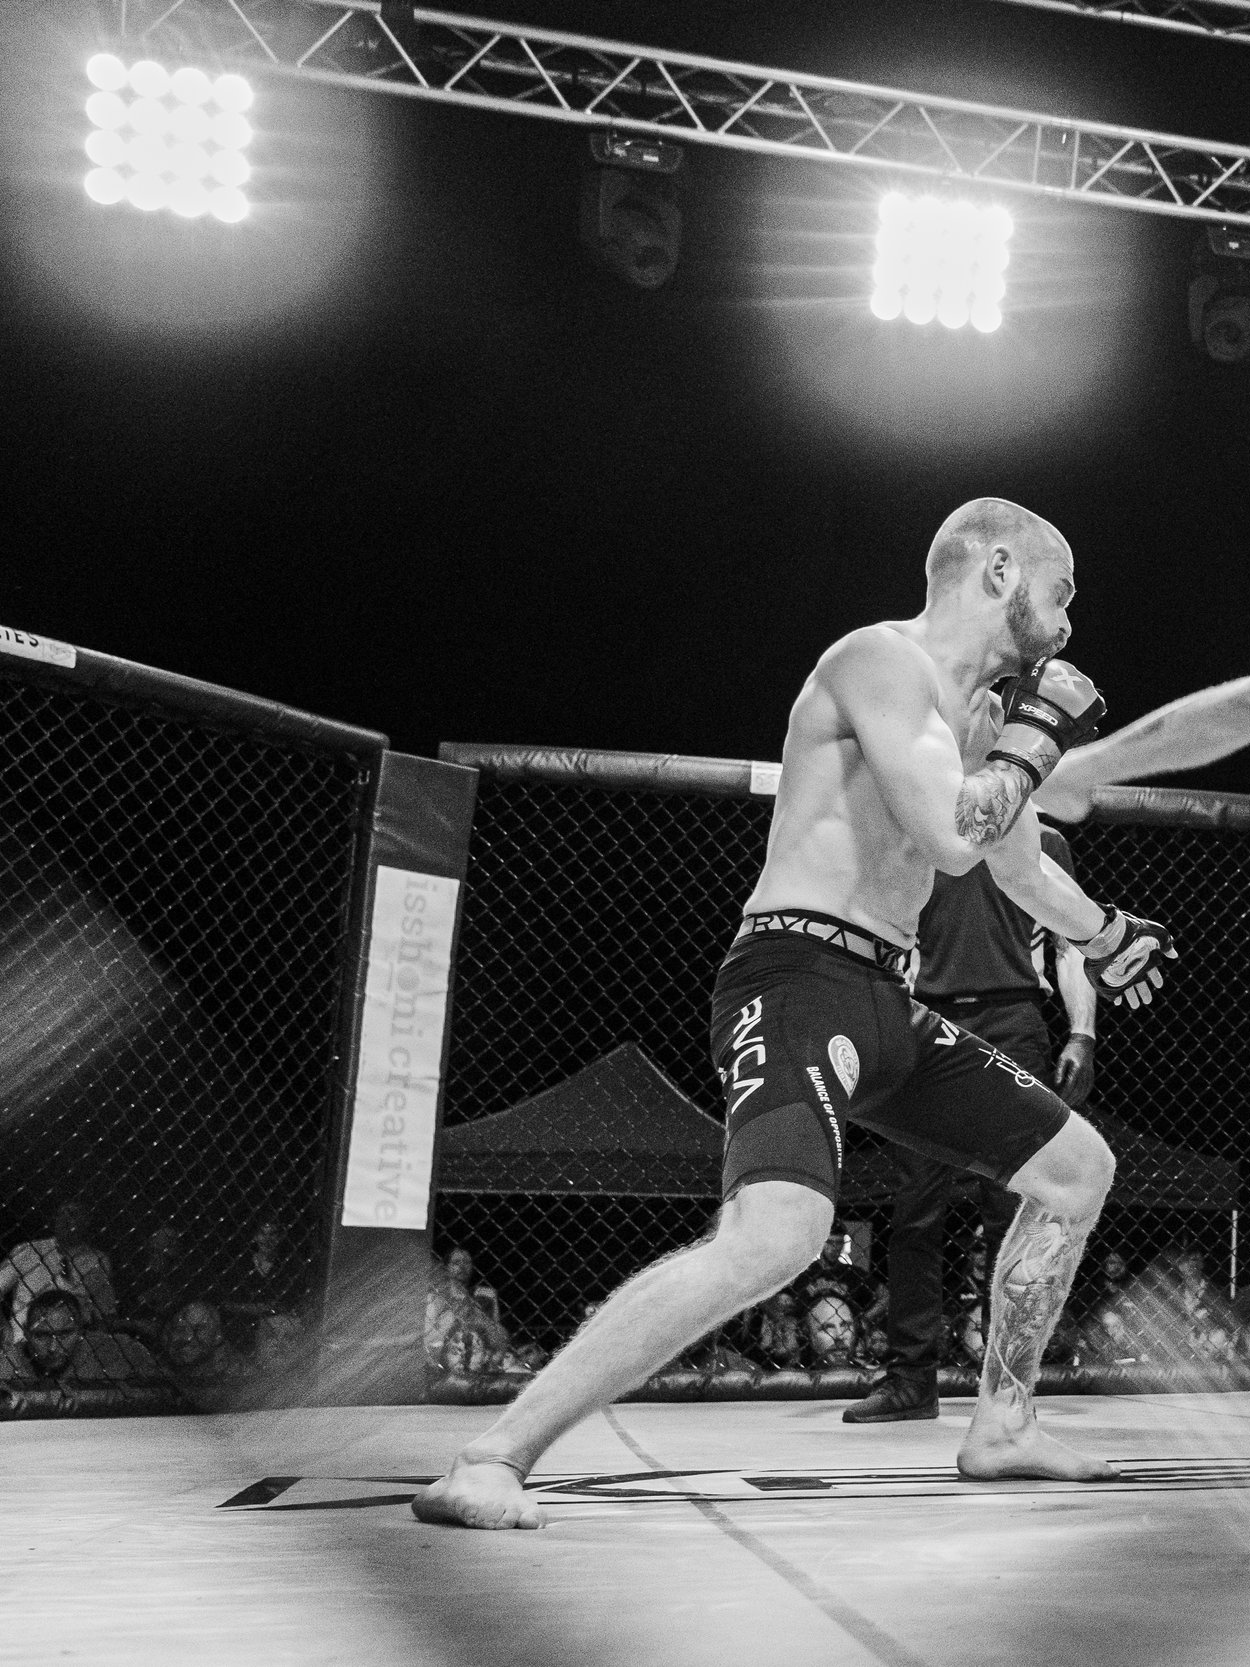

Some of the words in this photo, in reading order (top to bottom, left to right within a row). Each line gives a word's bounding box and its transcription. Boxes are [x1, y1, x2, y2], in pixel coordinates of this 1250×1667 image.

[1018, 703, 1058, 726] XPEED
[732, 995, 766, 1115] RVCA
[374, 1045, 416, 1223] creative
[806, 1066, 830, 1102] BALANCE
[823, 1103, 835, 1116] OF
[829, 1116, 842, 1169] OPPOSITES
